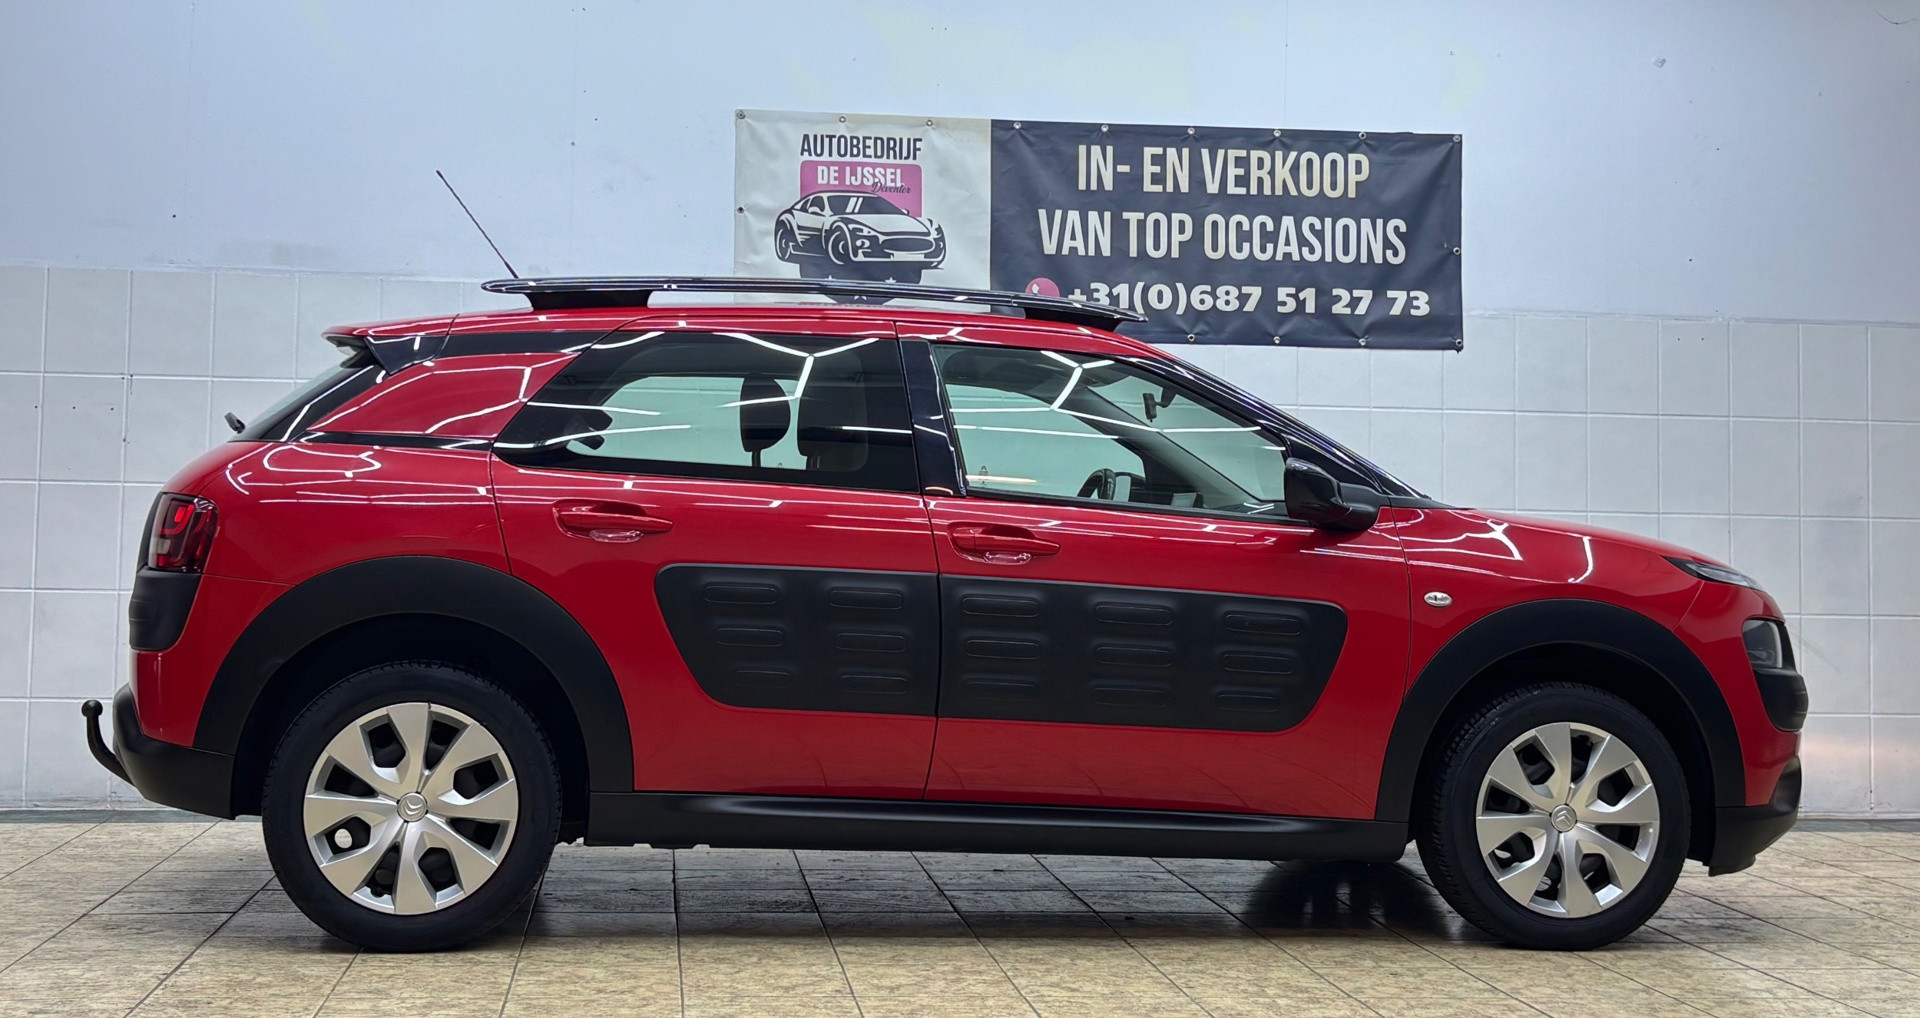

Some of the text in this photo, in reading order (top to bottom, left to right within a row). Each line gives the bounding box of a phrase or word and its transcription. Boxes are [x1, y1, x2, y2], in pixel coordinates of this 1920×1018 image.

[800, 134, 923, 160] AUTOBEDRIJF
[817, 166, 904, 187] DE IJSSEL
[1078, 144, 1370, 198] IN- EN VERKOOP
[871, 182, 912, 194] Deventer
[1038, 208, 1407, 265] VAN TOP OCCASIONS
[1276, 286, 1316, 314] 51
[1331, 287, 1373, 315] 27
[1386, 289, 1431, 317] 73
